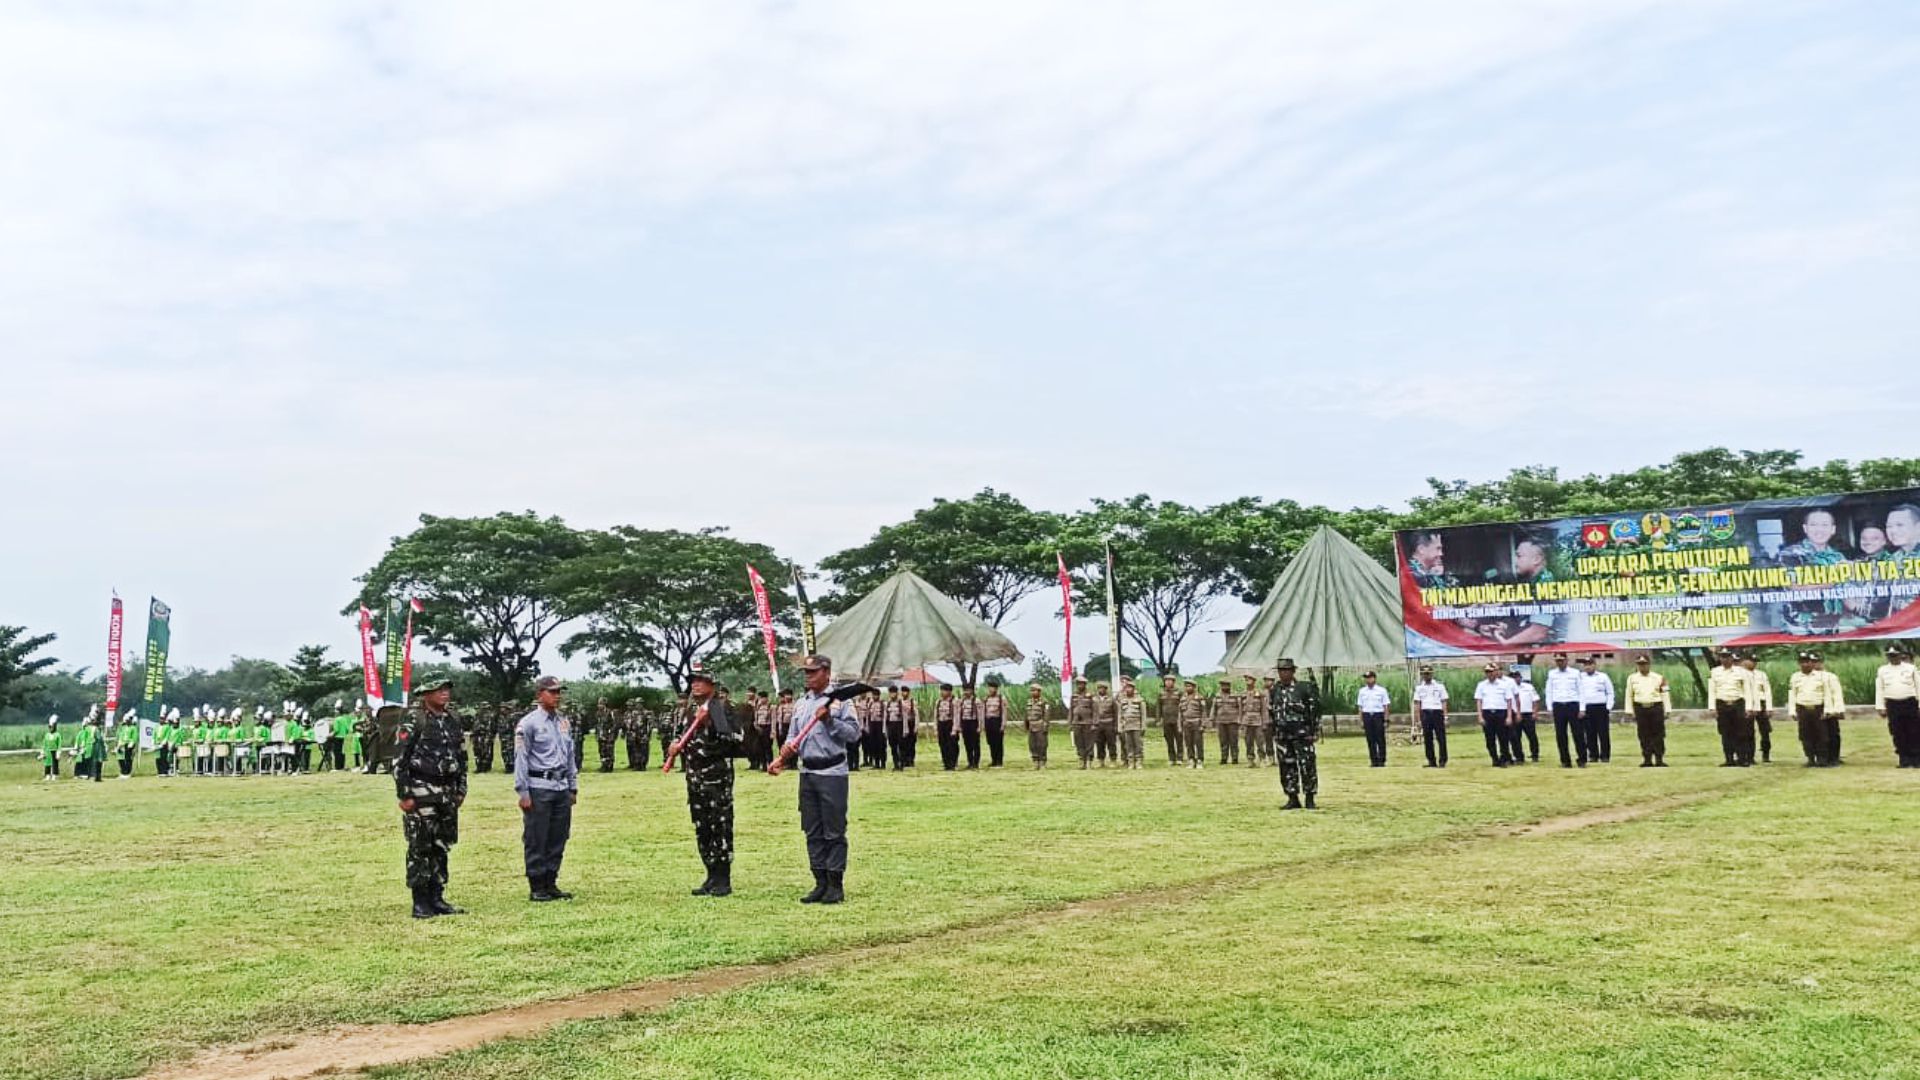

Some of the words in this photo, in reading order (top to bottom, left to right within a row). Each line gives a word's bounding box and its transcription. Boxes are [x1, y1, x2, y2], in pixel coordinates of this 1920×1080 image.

[1577, 555, 1650, 575] UPACARA
[1652, 546, 1750, 571] PENUTUPAN
[1420, 588, 1443, 607] TNI
[1446, 583, 1534, 605] MANUNGGAL
[1536, 576, 1633, 600] MEMBANGUN
[1635, 574, 1677, 595] DESA
[1679, 567, 1792, 592] SENGKUYUNG
[1794, 563, 1851, 586] TAHAP
[1854, 562, 1874, 582] IV
[1877, 560, 1900, 580] TA
[1589, 613, 1639, 633] KODIM
